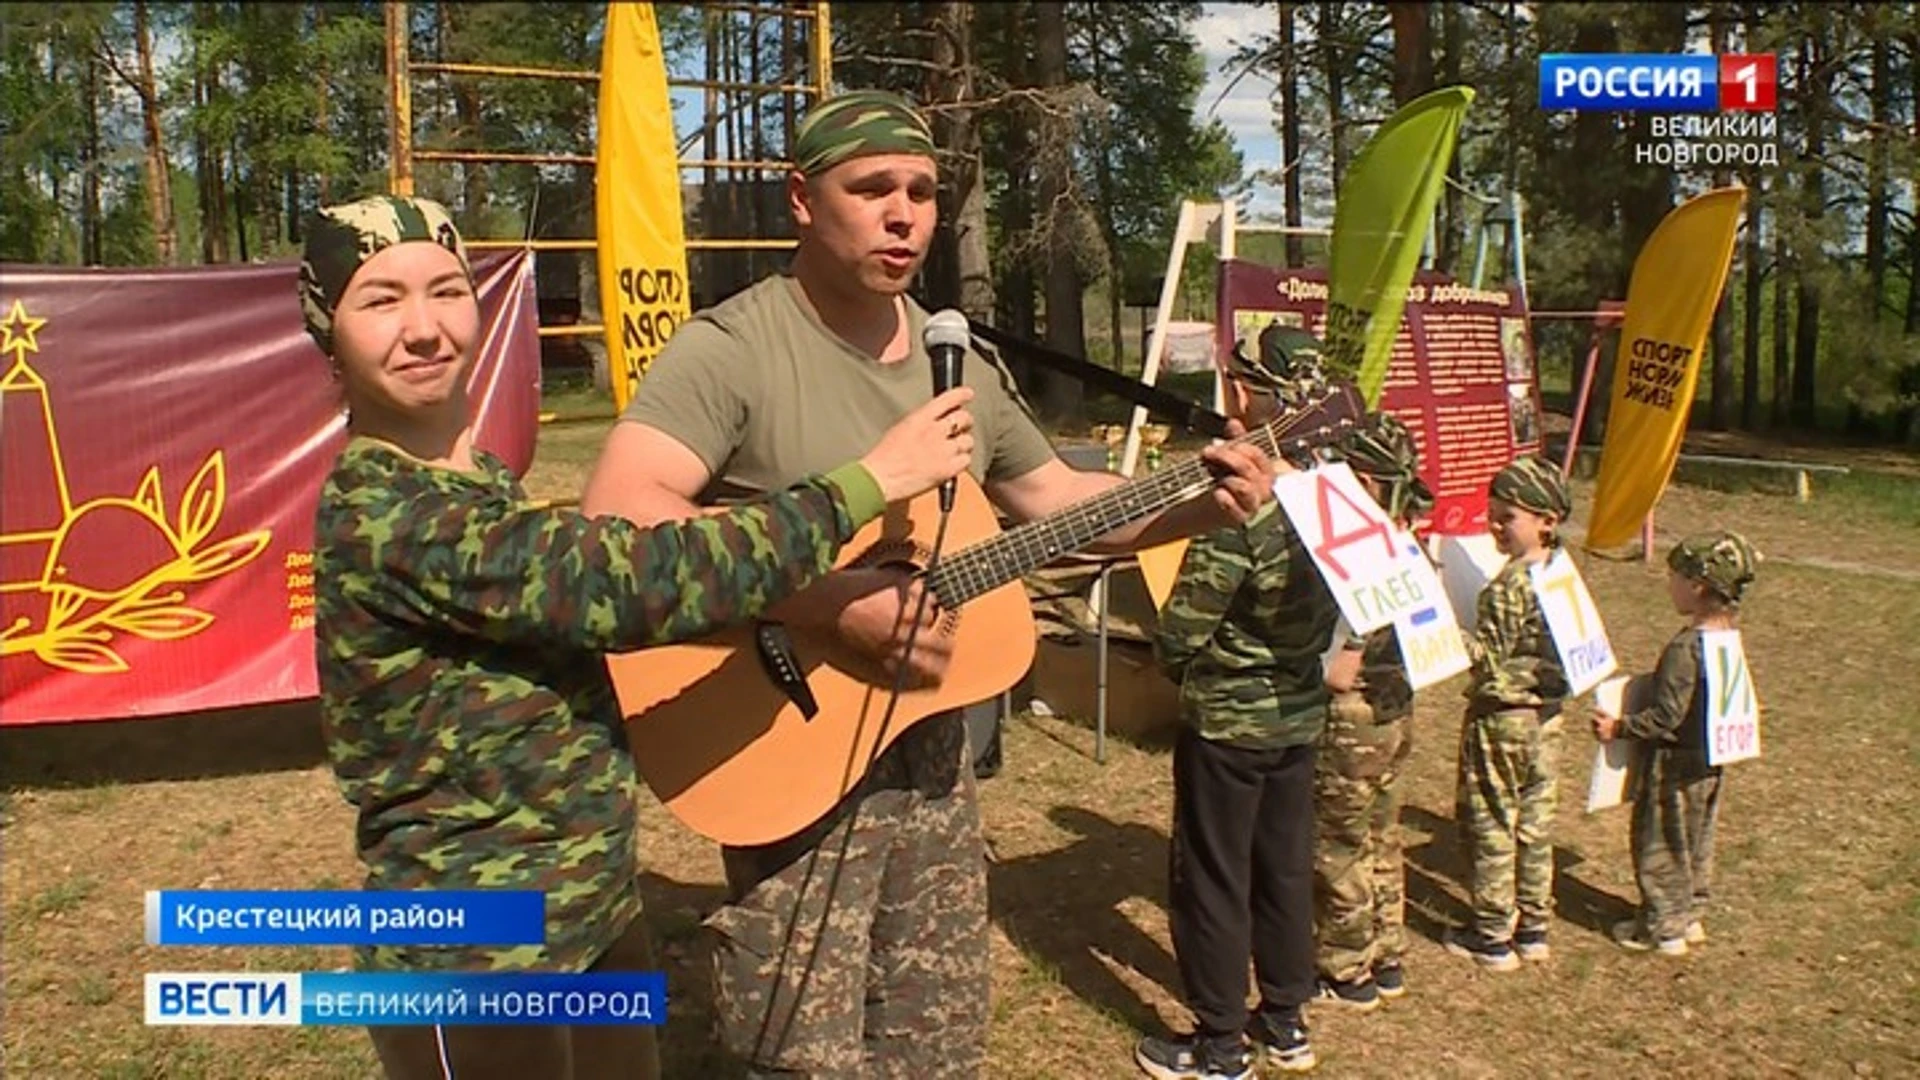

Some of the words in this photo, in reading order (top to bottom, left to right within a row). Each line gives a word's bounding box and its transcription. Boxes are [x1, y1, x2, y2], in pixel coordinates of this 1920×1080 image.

[1632, 338, 1692, 368] СПОРТ
[1313, 473, 1397, 582] Д
[1351, 568, 1426, 623] ГЛЕБ
[1544, 574, 1586, 641] Т
[1717, 645, 1750, 719] И
[1716, 722, 1755, 755] ЕГОР
